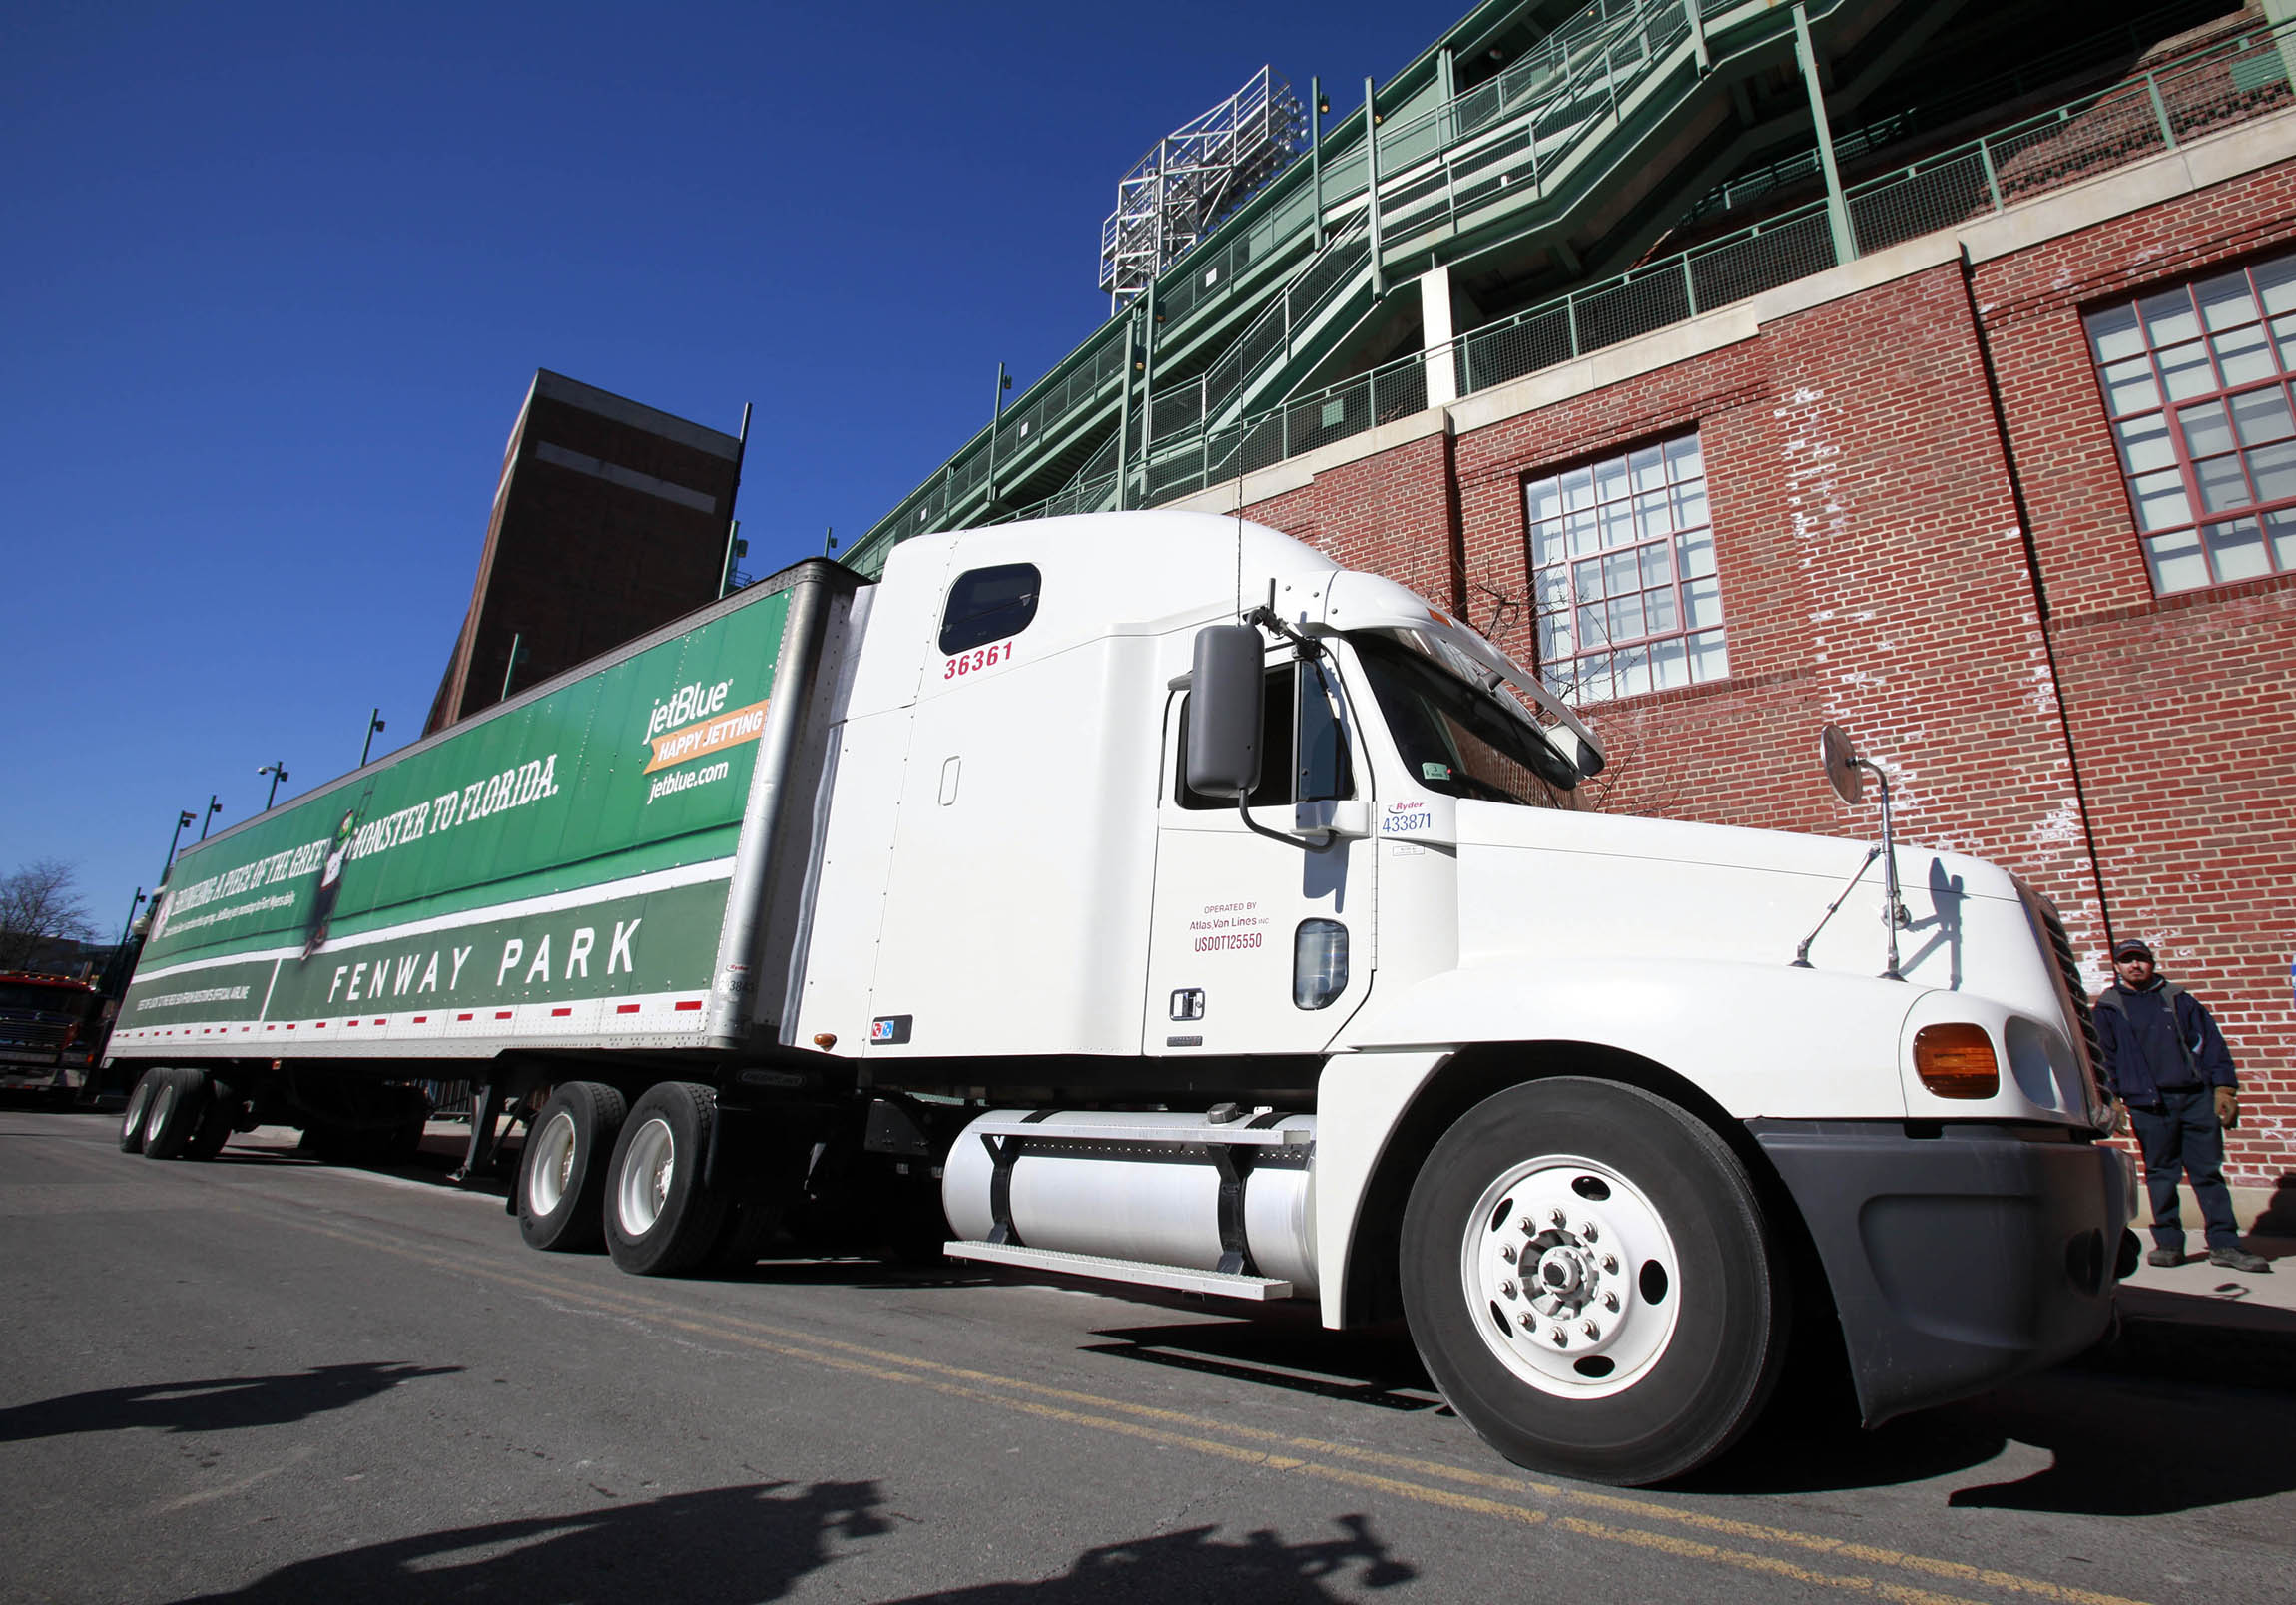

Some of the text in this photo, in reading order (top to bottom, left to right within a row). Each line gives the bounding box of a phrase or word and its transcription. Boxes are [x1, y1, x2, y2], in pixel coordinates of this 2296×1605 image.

[944, 641, 1012, 680] 36361
[642, 681, 729, 745] jetBlue
[658, 710, 763, 762] HAPPY JETTING
[647, 761, 729, 805] jetblue.com
[249, 859, 272, 889] OF
[265, 849, 295, 885] THE
[429, 791, 459, 834] TO
[455, 754, 559, 825] FLORIDA.
[1382, 813, 1430, 833] 433871
[1396, 802, 1425, 810] Ryder
[1204, 903, 1244, 914] OPERATED
[1232, 917, 1257, 926] Lines
[327, 918, 642, 1003] FENWAY PARK
[1195, 933, 1262, 952] USDOT125550
